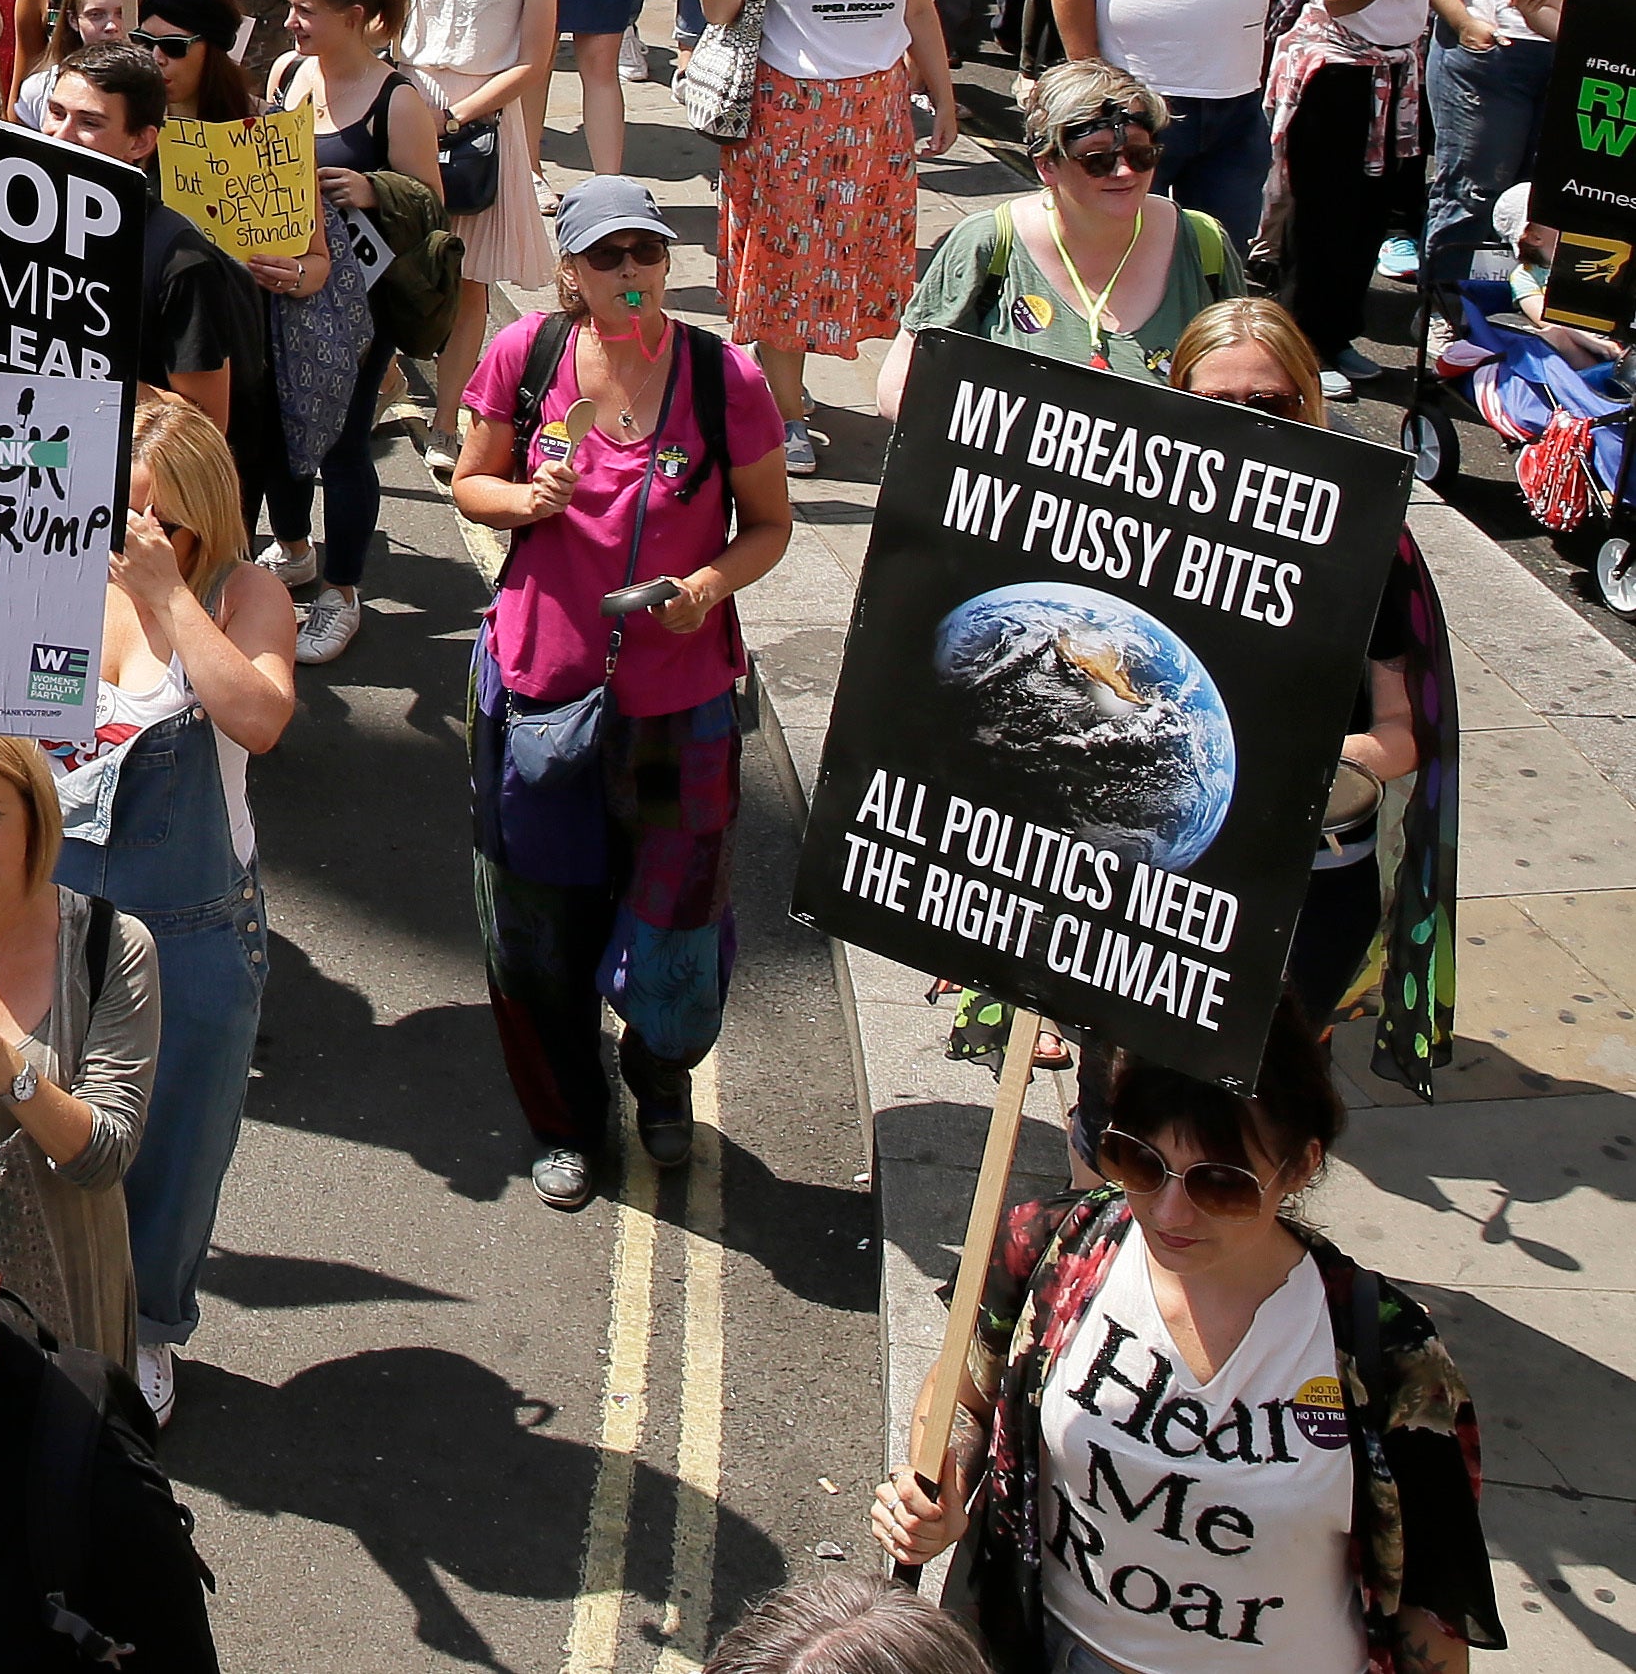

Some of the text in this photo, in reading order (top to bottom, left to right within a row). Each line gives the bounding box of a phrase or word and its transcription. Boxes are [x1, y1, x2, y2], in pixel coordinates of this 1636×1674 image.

[947, 379, 1342, 547] MY BREASTS FEED
[942, 465, 1304, 628] MY PUSSY BITES
[841, 832, 1232, 1032] THE RIGHT CLIMATE
[856, 767, 1239, 955] ALL POLITICS NEED
[1065, 1312, 1300, 1465] Hear
[1045, 1484, 1285, 1646] Roar
[1080, 1439, 1255, 1556] Me
